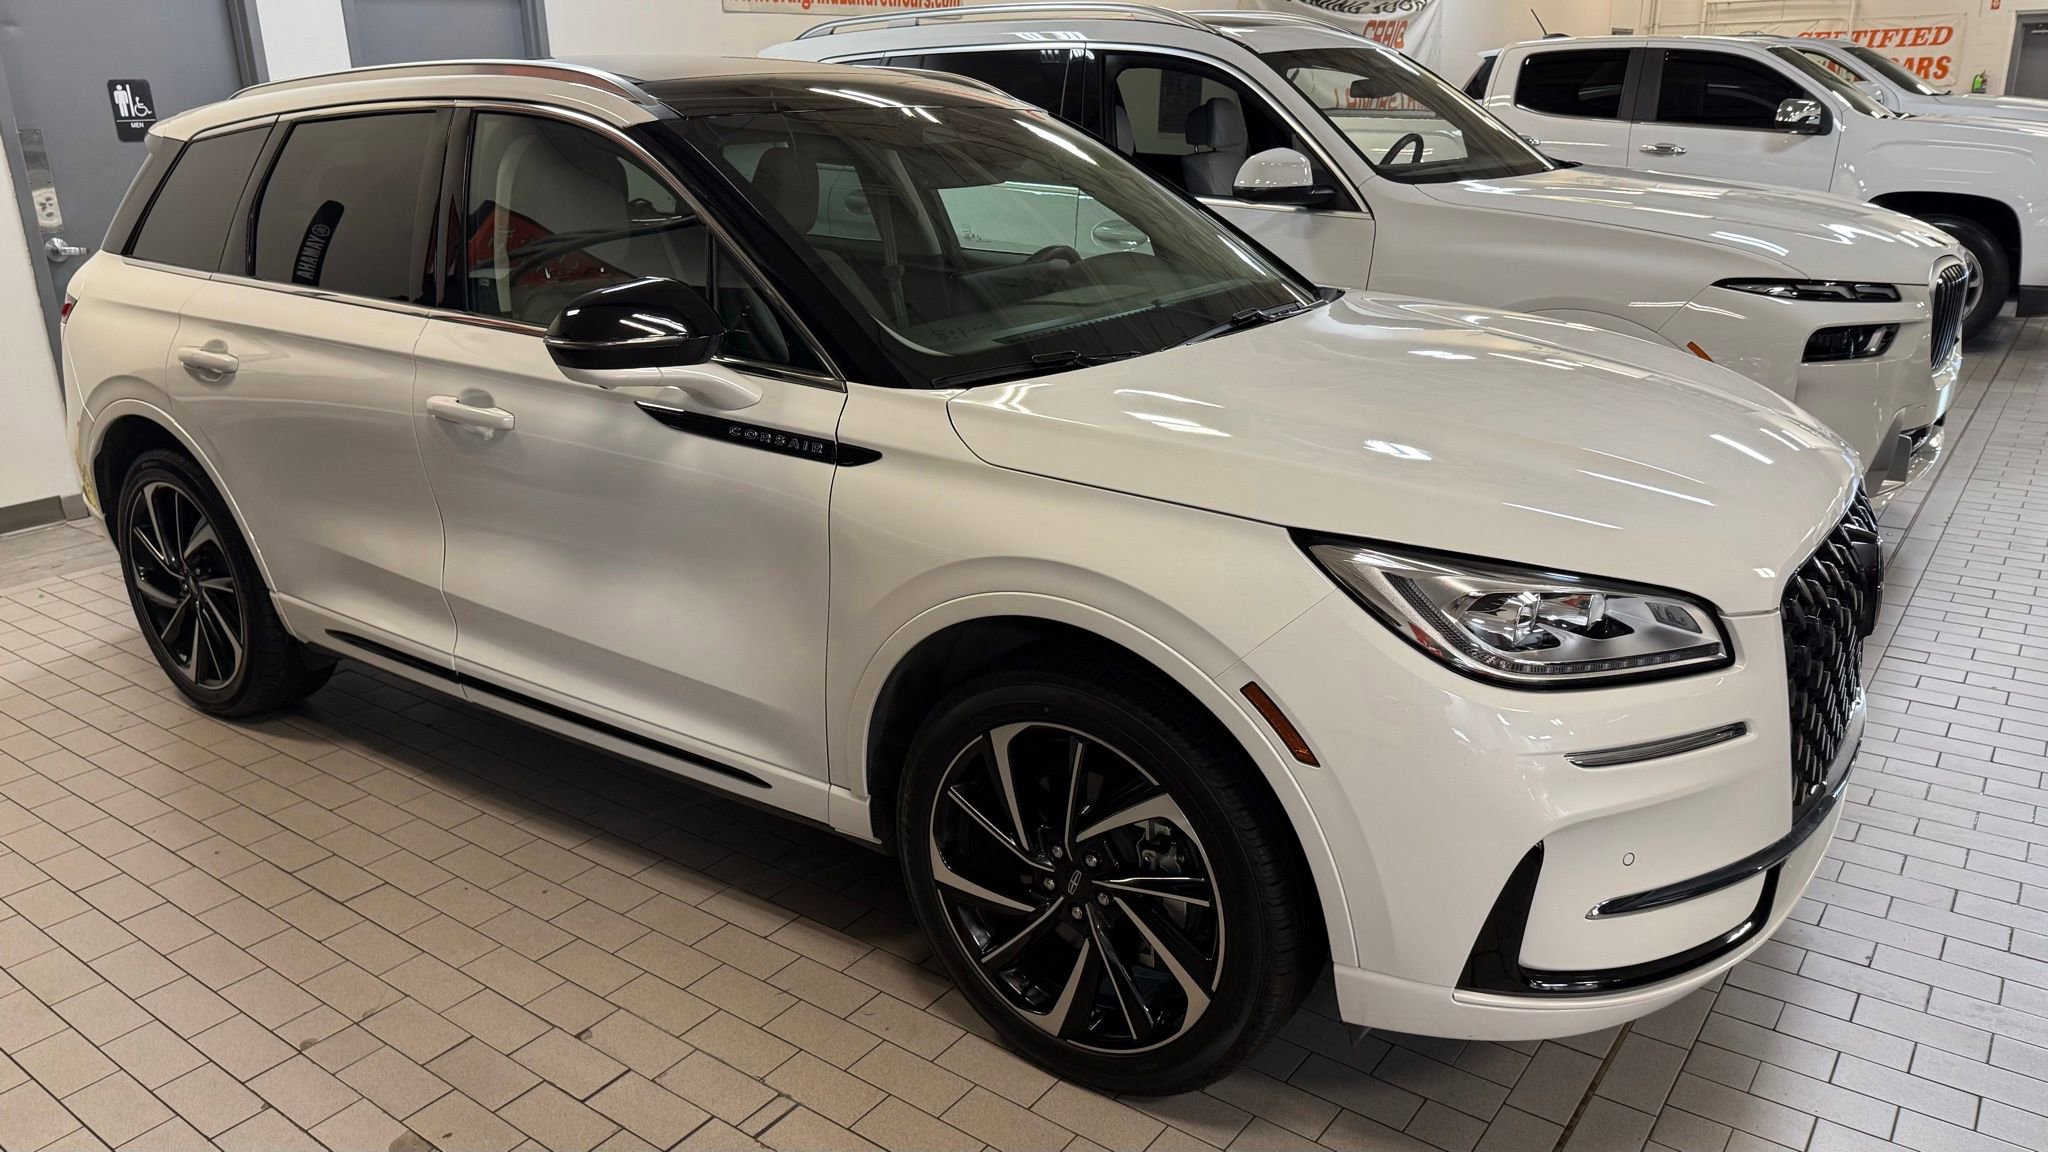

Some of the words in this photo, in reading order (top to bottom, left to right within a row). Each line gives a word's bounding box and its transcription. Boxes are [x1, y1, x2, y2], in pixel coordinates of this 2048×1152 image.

[1363, 19, 1409, 49] CRAIG
[1890, 55, 1952, 80] ARS
[729, 425, 823, 454] CORSAIR
